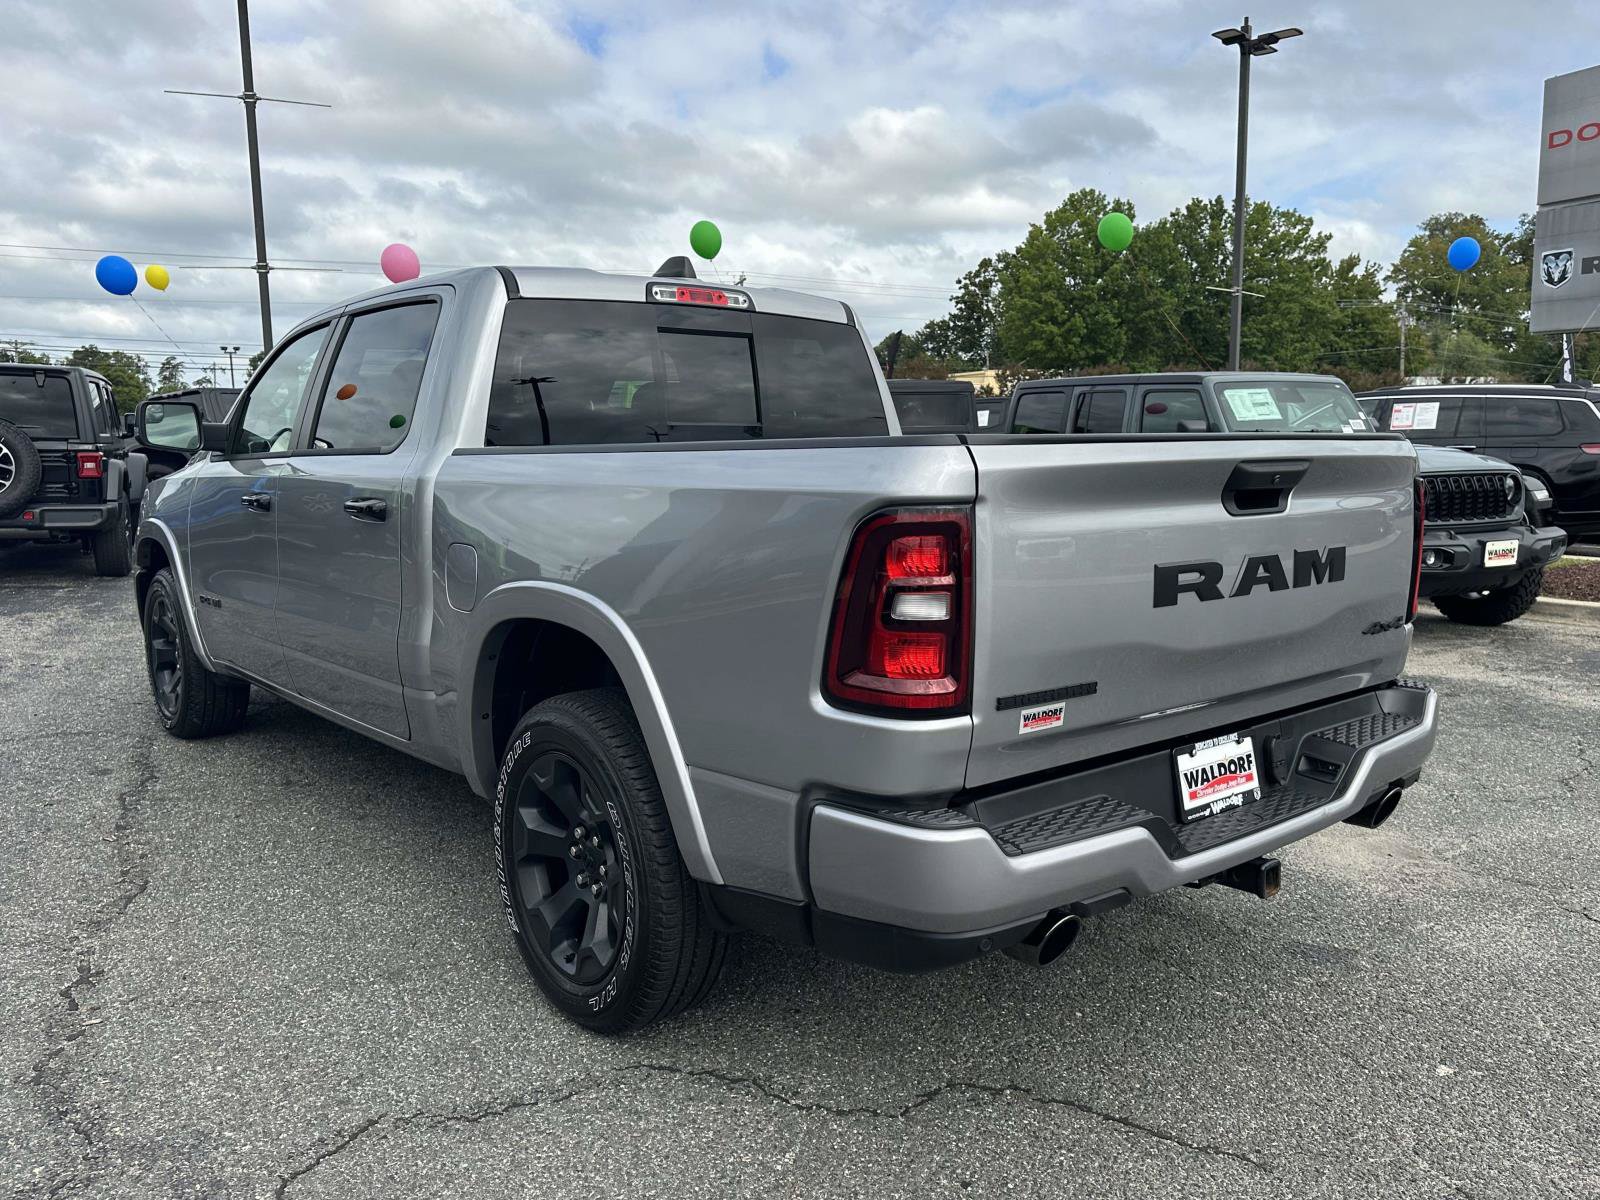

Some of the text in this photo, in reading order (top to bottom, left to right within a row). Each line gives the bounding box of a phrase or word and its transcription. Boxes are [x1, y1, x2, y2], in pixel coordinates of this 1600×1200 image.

[1488, 548, 1516, 557] WALDORF
[1153, 545, 1347, 608] RAM
[1023, 707, 1063, 722] WALDORF
[1183, 753, 1253, 790] WALDORF
[493, 732, 531, 933] BRIDGESTONE
